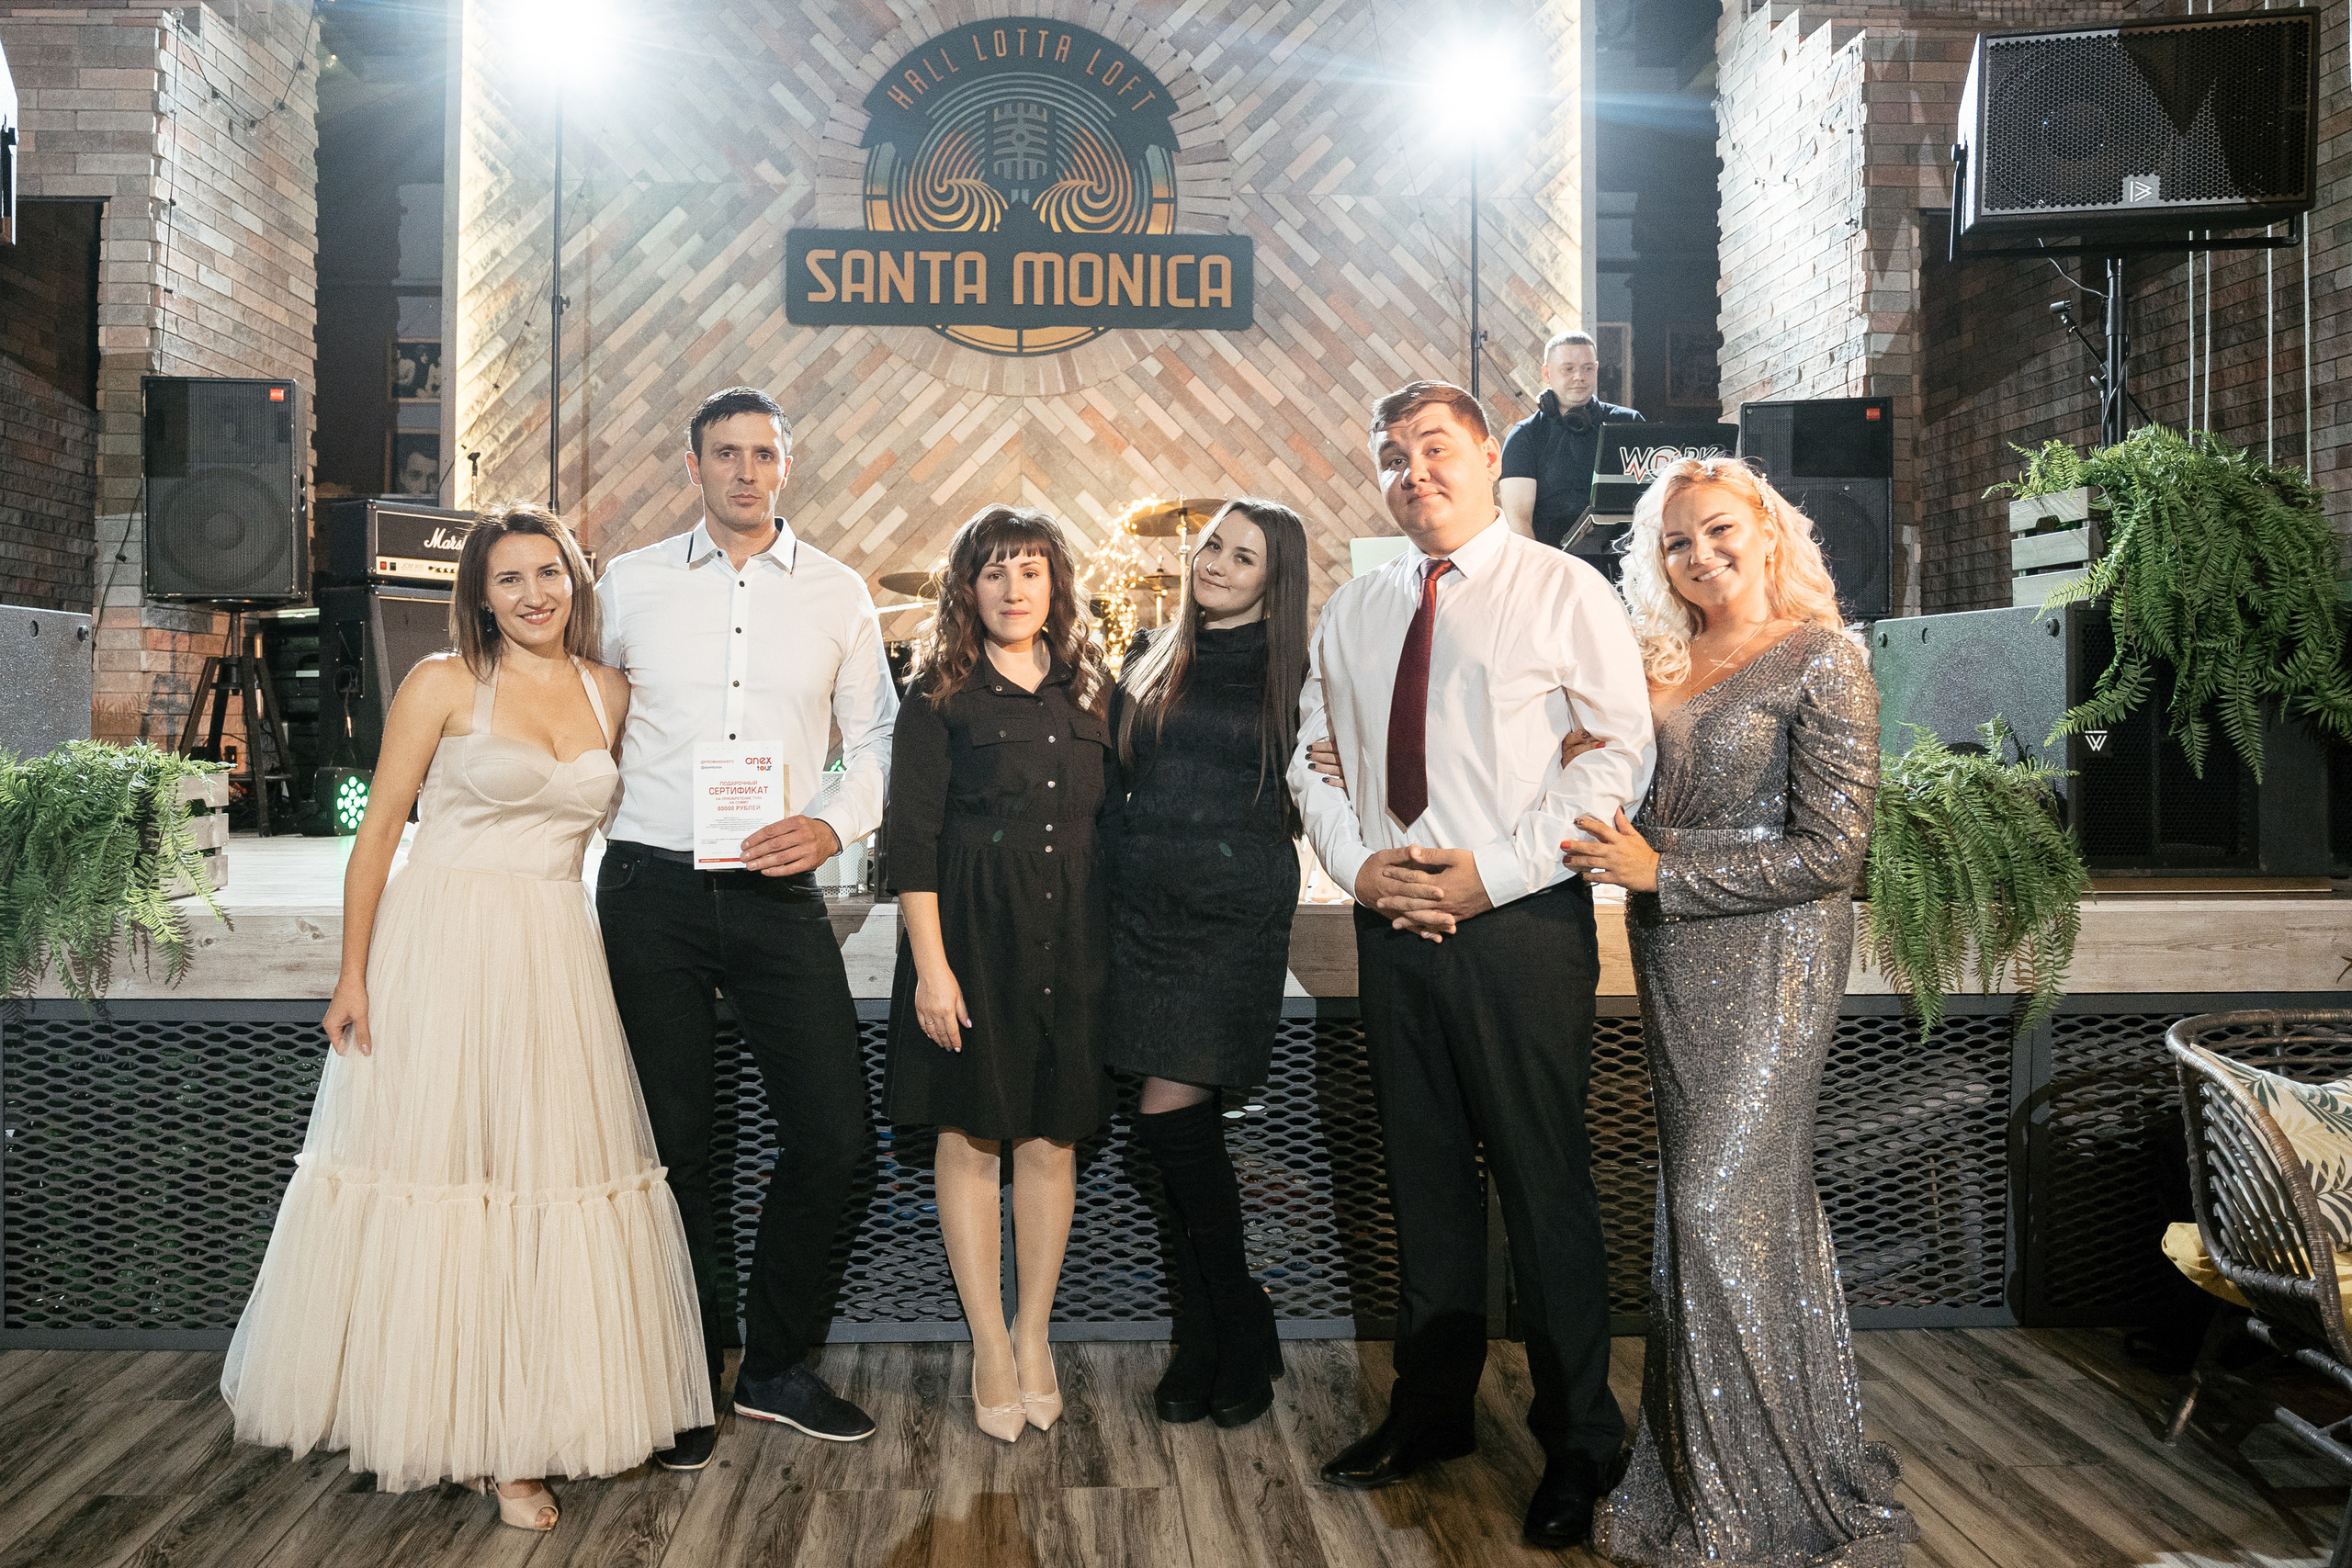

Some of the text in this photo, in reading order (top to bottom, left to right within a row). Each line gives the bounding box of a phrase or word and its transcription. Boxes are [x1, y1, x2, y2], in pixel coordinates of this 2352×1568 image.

[886, 28, 1157, 112] HALL LOTTA LOFT
[805, 249, 1233, 309] SANTA MONICA
[708, 786, 769, 795] СЕРТИФИКАТ
